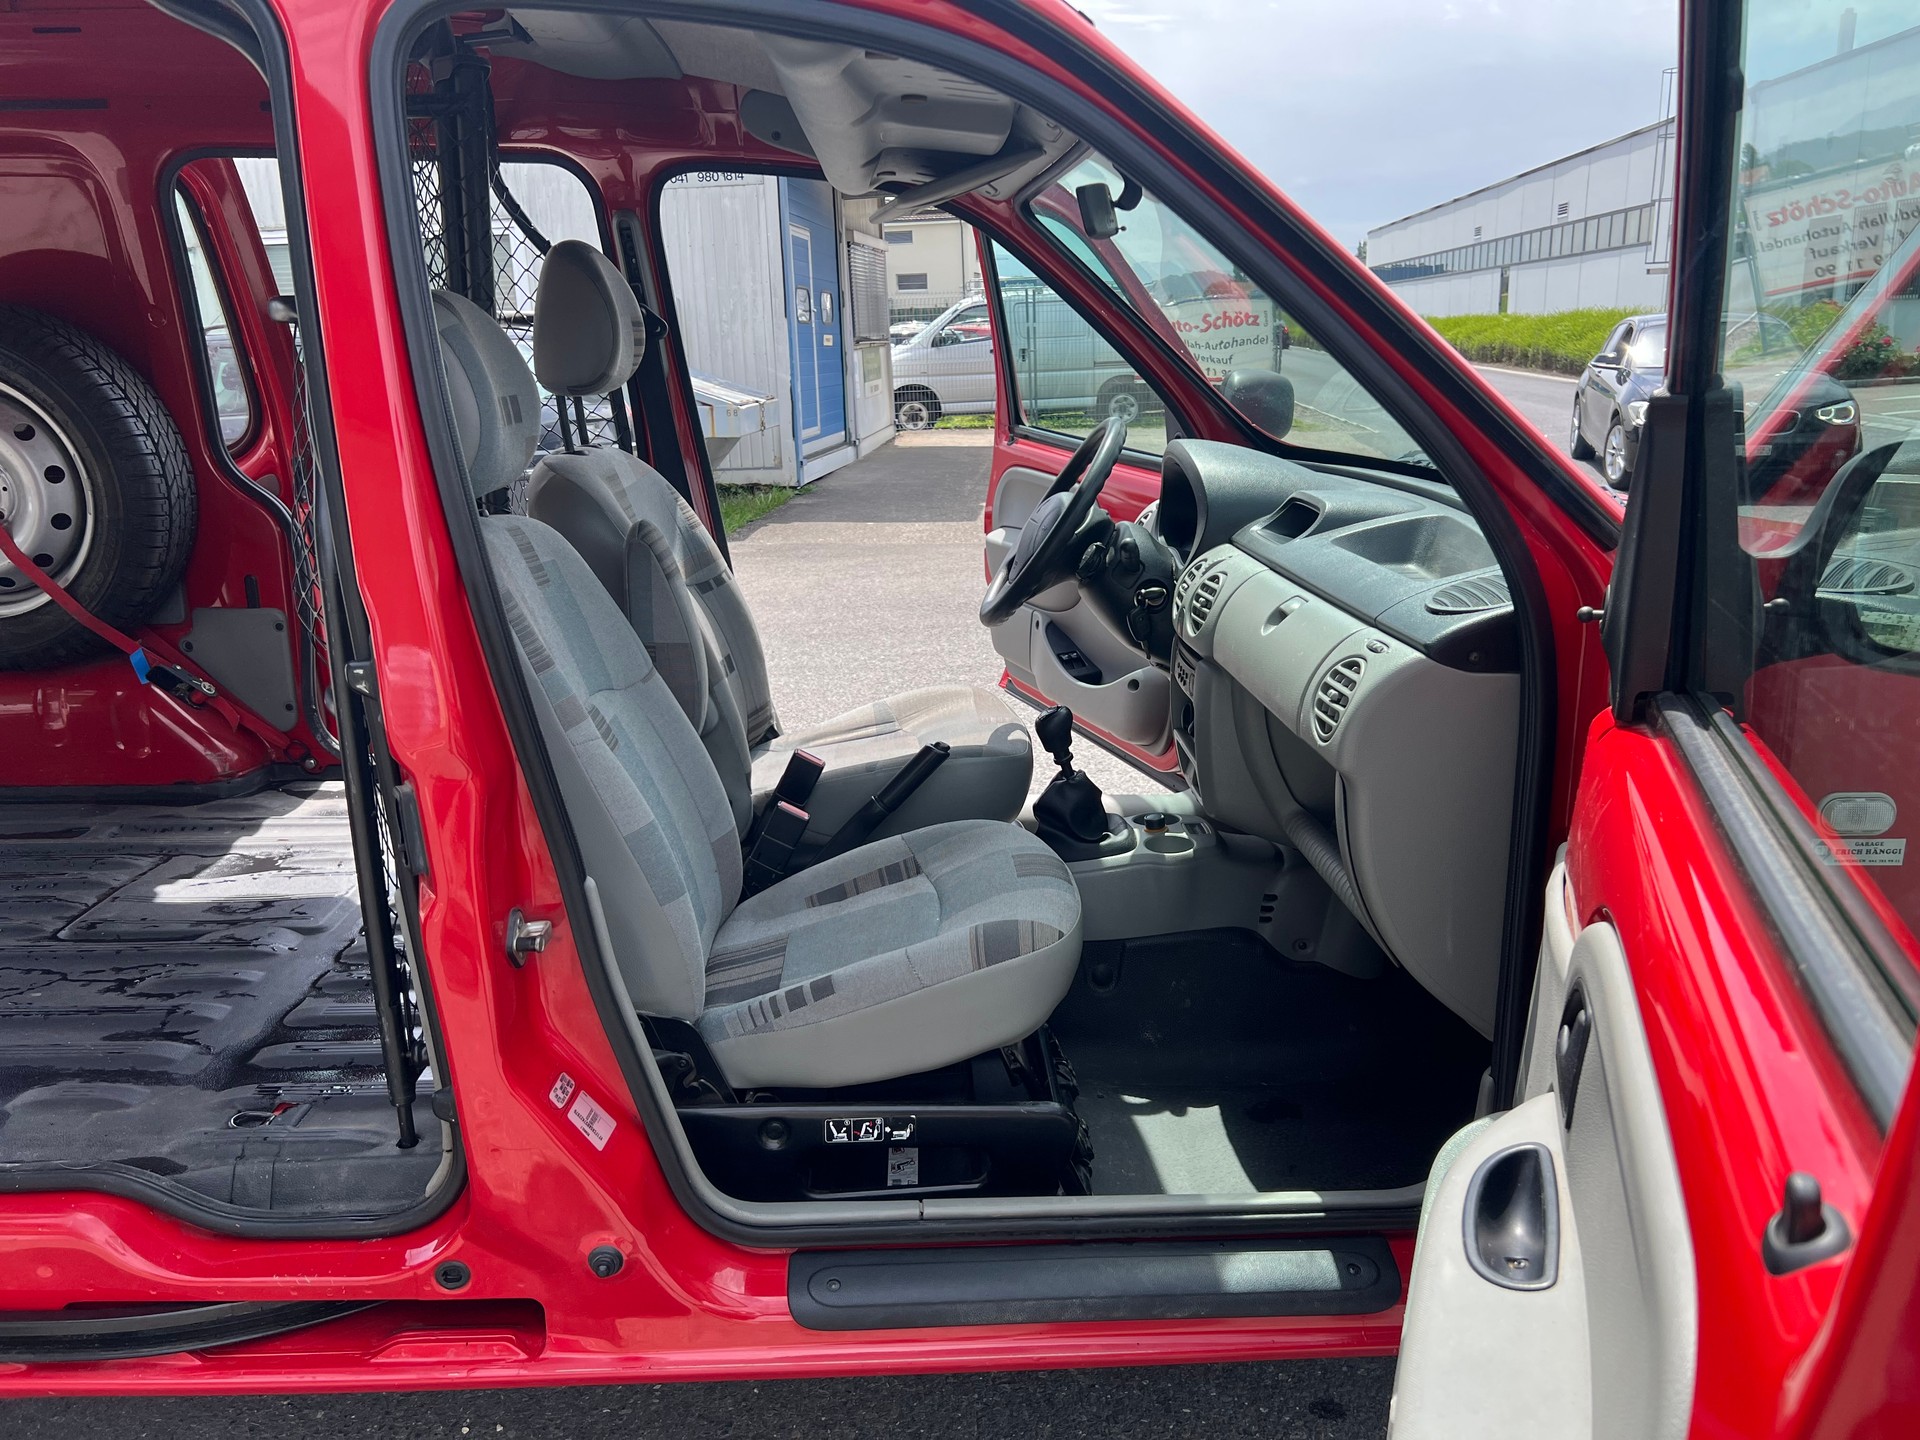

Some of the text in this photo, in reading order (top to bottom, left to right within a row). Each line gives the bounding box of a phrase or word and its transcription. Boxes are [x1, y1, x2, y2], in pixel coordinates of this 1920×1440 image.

[697, 172, 719, 182] 980
[722, 172, 744, 181] 1814
[1194, 353, 1233, 365] Verkauf
[1865, 847, 1902, 855] HÄNGGI
